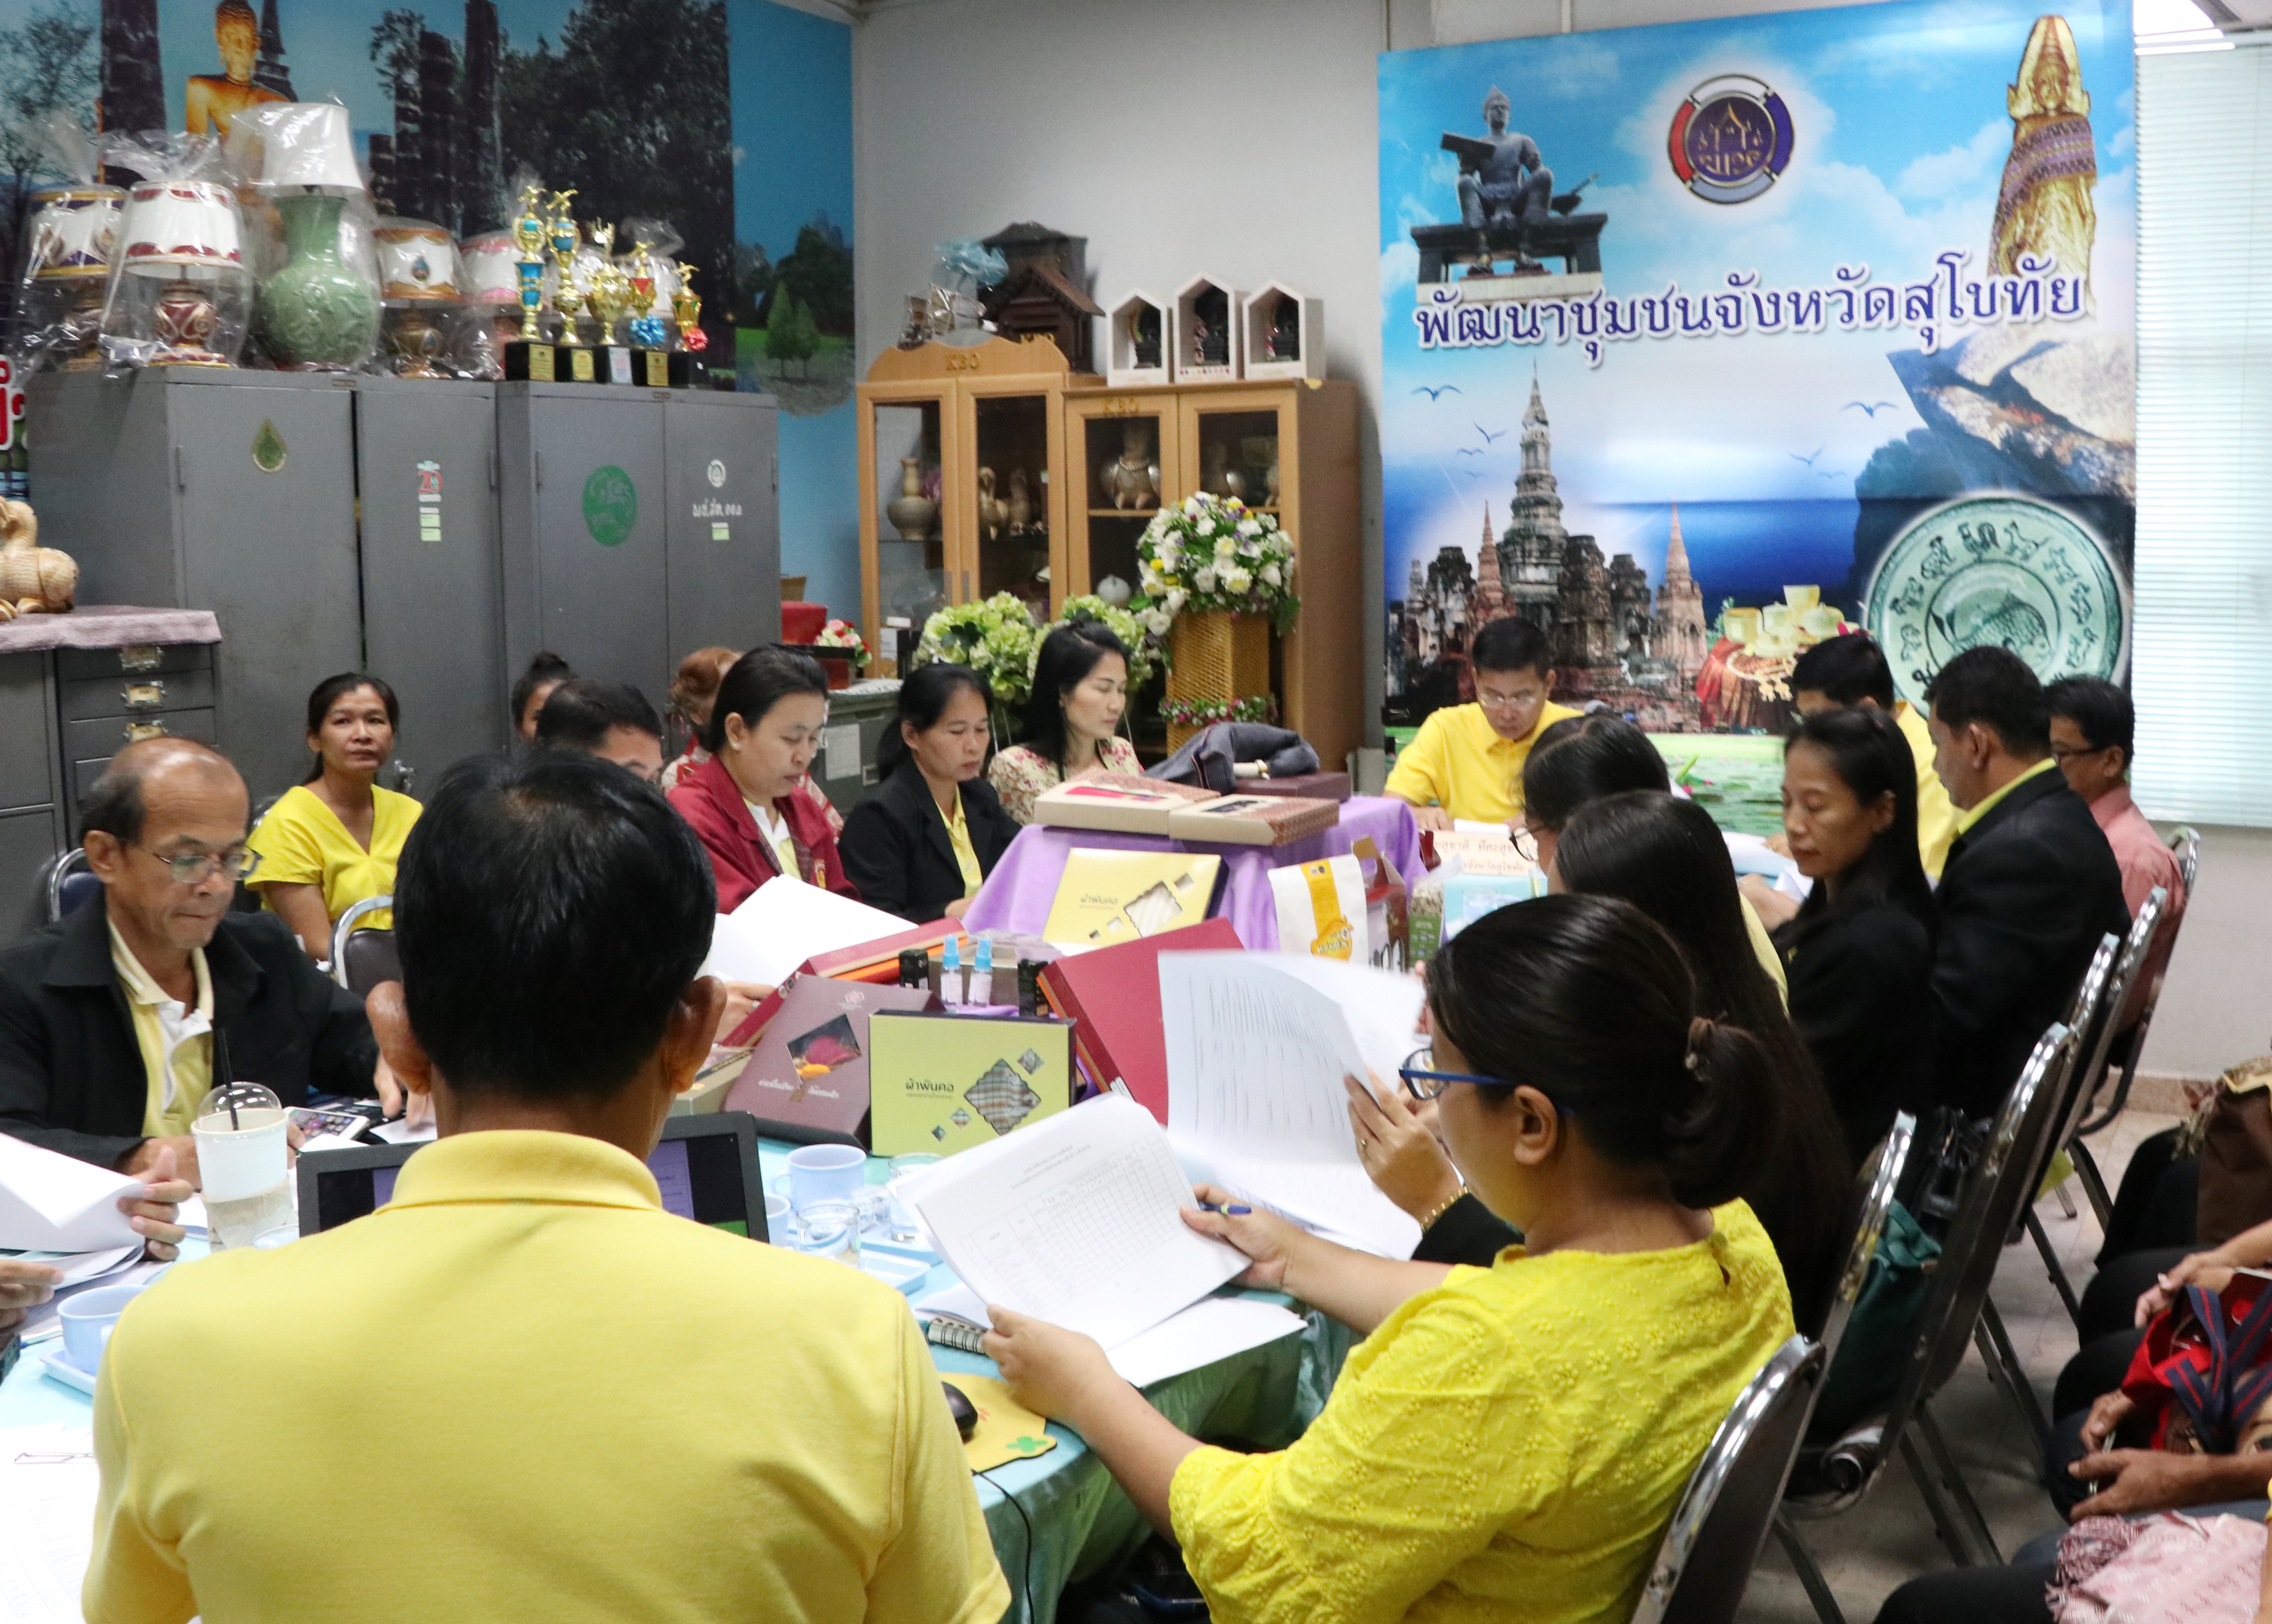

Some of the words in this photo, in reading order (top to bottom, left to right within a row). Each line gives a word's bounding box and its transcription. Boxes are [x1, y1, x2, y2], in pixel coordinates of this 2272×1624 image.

[1416, 252, 2080, 362] พัฒนาชุมชนจังหวัดสุโขทัย
[906, 1078, 954, 1093] ผ้าพันคอ
